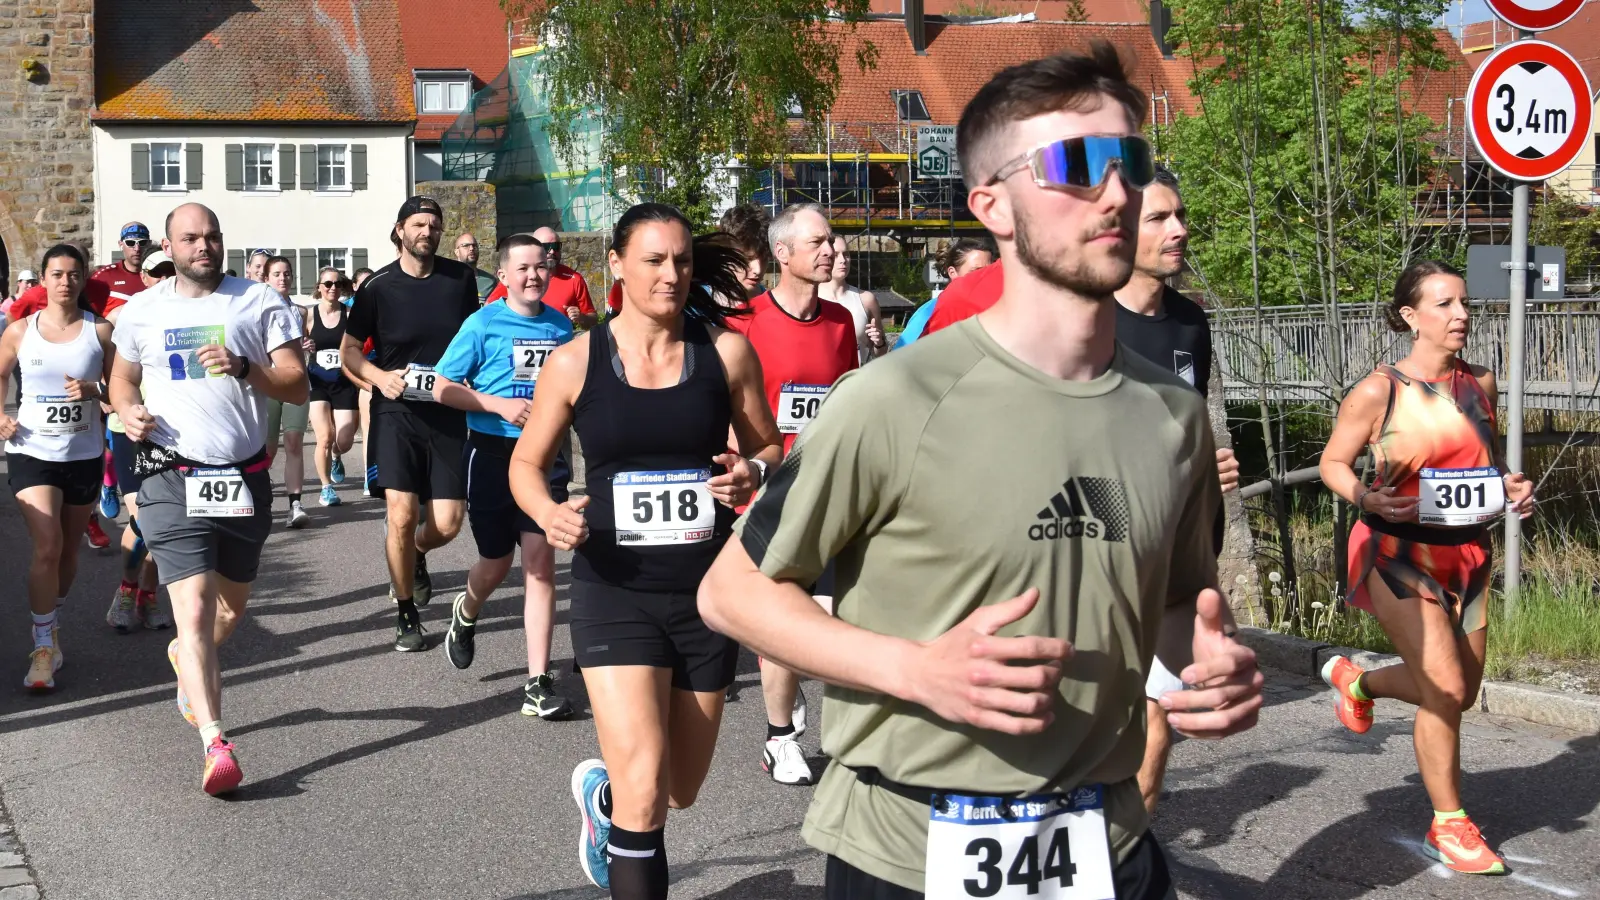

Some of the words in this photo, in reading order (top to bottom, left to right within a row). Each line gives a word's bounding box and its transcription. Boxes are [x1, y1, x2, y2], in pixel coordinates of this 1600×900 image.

[176, 337, 207, 345] Triathlon
[524, 349, 553, 368] 27
[46, 405, 83, 424] 293
[630, 474, 666, 483] Herrieder
[666, 472, 698, 482] Stadtlauf
[198, 480, 243, 502] 497
[1434, 482, 1486, 509] 301
[632, 489, 699, 524] 518
[619, 533, 648, 542] schüller.
[1027, 517, 1099, 541] adidas
[963, 826, 1078, 898] 344
